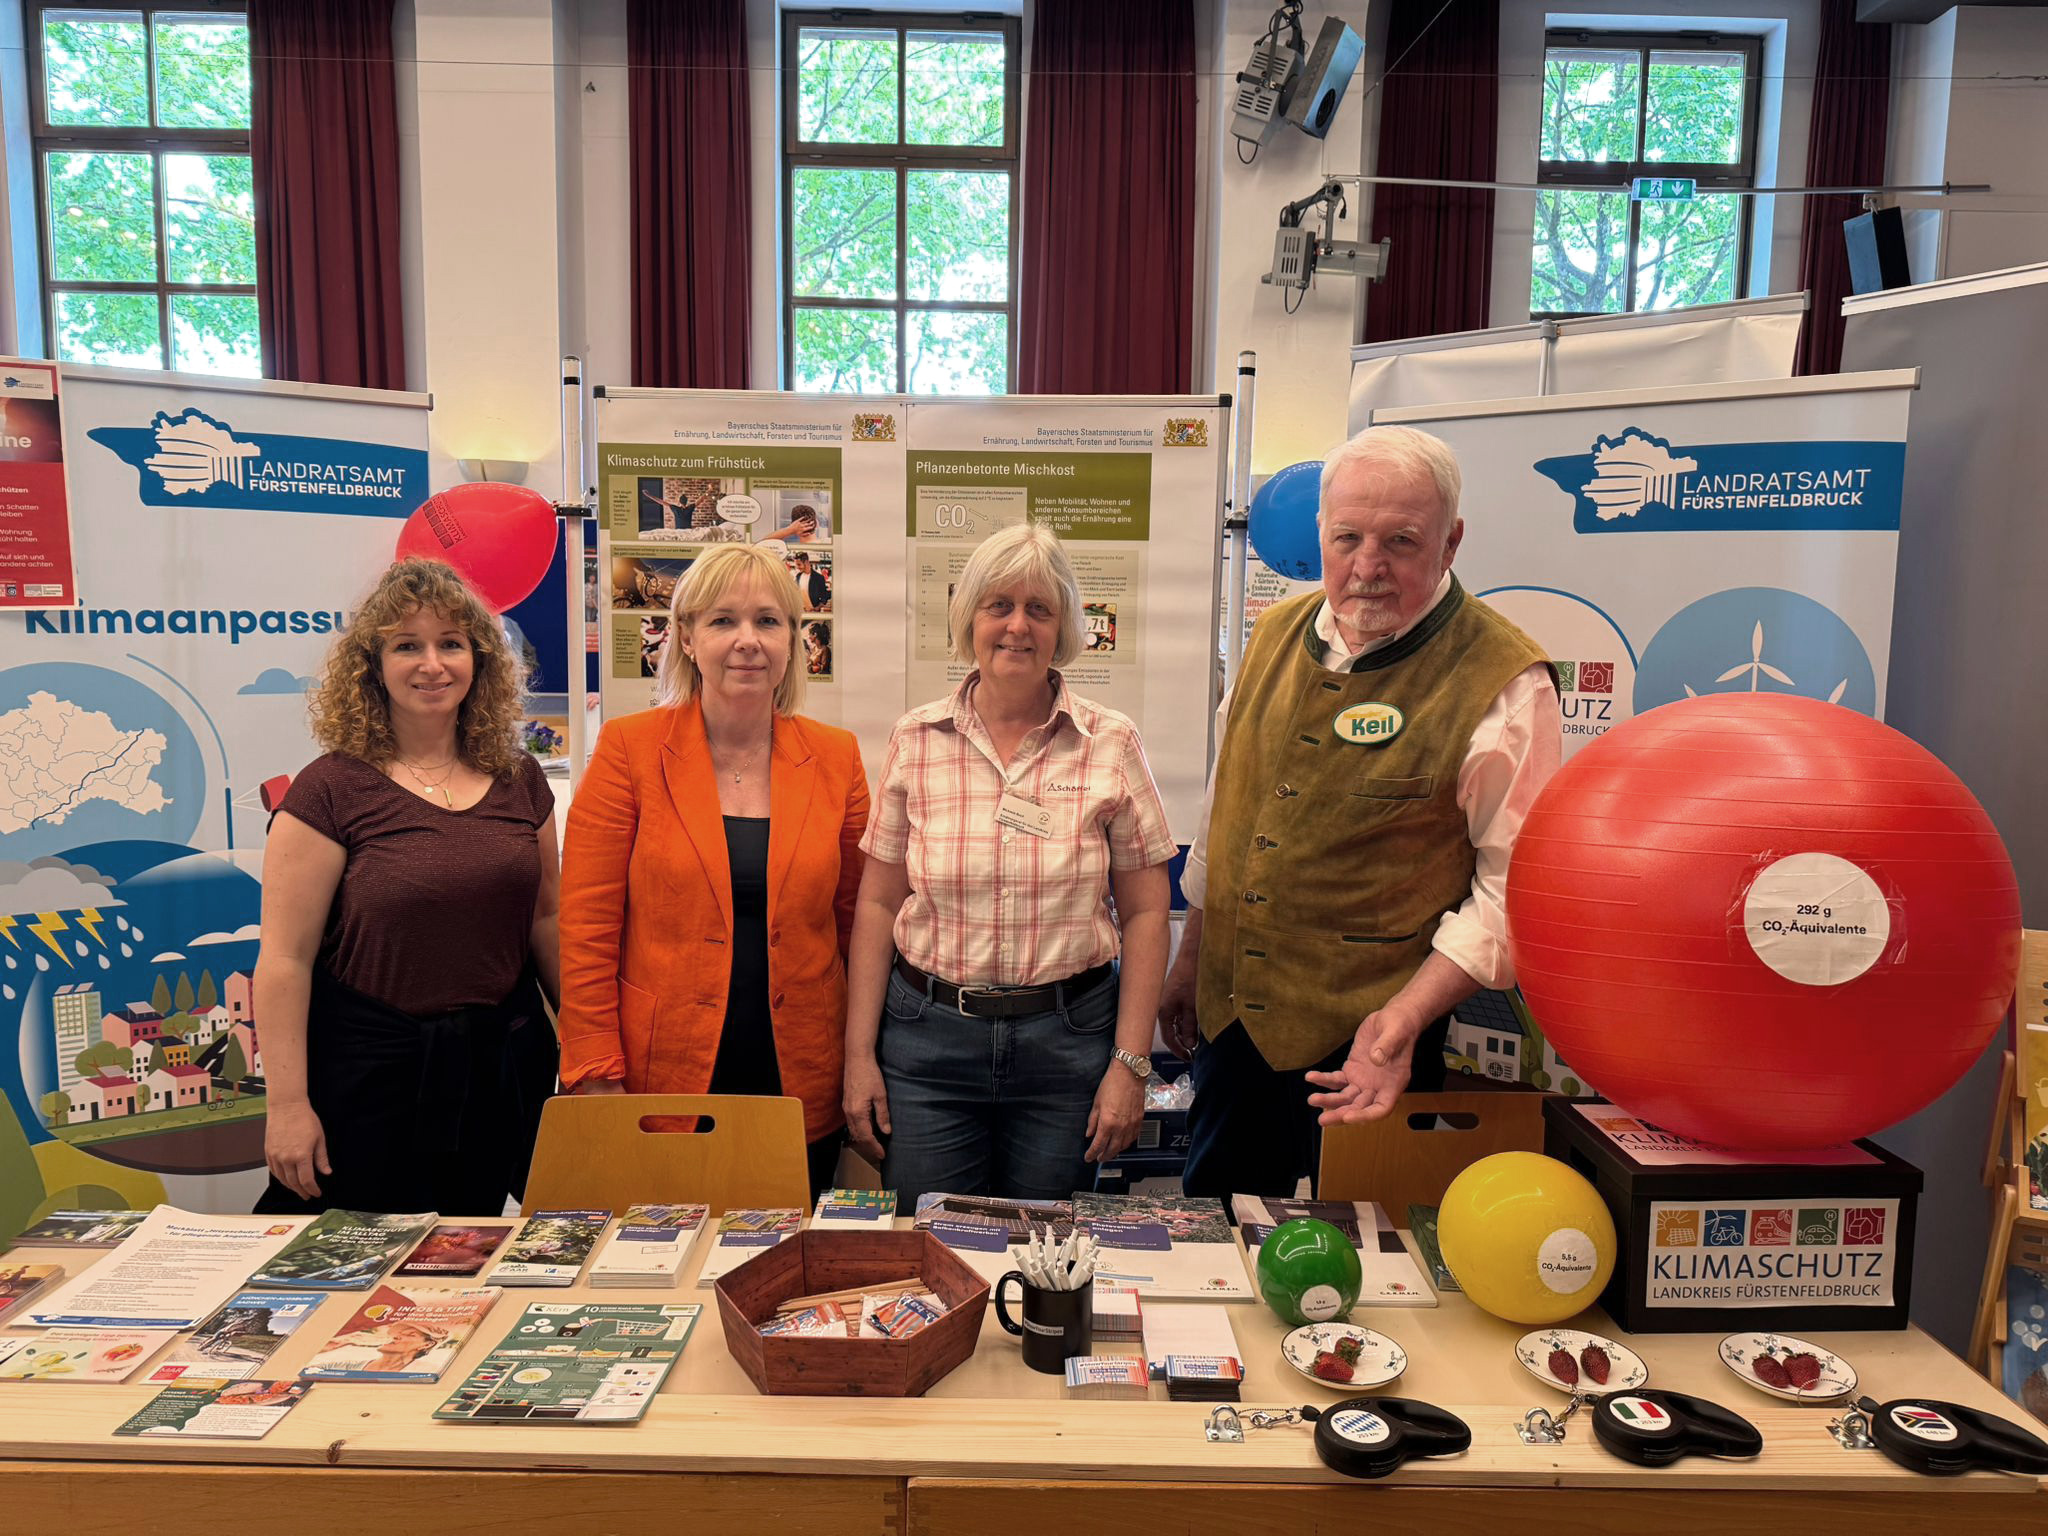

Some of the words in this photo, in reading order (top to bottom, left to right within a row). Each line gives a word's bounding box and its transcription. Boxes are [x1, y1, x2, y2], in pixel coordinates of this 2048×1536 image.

[727, 421, 769, 432] Bayerisches
[770, 422, 830, 432] Staatsministerium
[831, 422, 842, 431] für
[1037, 427, 1079, 438] Bayerisches
[1080, 428, 1142, 438] Staatsministerium
[1143, 428, 1154, 437] für
[674, 430, 711, 440] Ernährung,
[712, 430, 765, 441] Landwirtschaft,
[766, 431, 793, 440] Forsten
[794, 431, 807, 440] und
[808, 432, 842, 441] Tourismus
[983, 436, 1020, 446] Ernährung,
[1021, 436, 1075, 447] Landwirtschaft,
[1076, 437, 1103, 446] Forsten
[1104, 437, 1117, 446] und
[1118, 438, 1153, 447] Tourismus
[606, 453, 678, 468] Klimaschutz
[680, 457, 704, 468] zum
[707, 455, 765, 470] Frühstück
[249, 459, 406, 485] LANDRATSAMT
[916, 461, 1010, 476] Pflanzenbetonte
[1013, 462, 1075, 476] Mischkost
[249, 476, 402, 499] FÜRSTENFELDBRUCK
[1683, 468, 1872, 495] LANDRATSAMT
[1034, 497, 1056, 506] Neben
[1057, 497, 1088, 507] Mobilität,
[1089, 498, 1116, 506] Wohnen
[1118, 498, 1131, 506] und
[1682, 491, 1864, 510] FÜRSTENFELDBRUCK
[1034, 506, 1061, 514] anderen
[1062, 506, 1122, 515] Konsumbereichen
[1053, 514, 1070, 523] auch
[1071, 514, 1081, 523] die
[1082, 514, 1116, 525] Ernährung
[1117, 515, 1132, 523] eine
[1055, 523, 1073, 531] Rolle.
[1351, 715, 1394, 737] Keil
[1796, 904, 1820, 915] 292
[1823, 907, 1832, 918] g
[166, 1224, 204, 1232] Merkblatt
[341, 1225, 409, 1233] KLIMASCHUTZ
[1653, 1252, 1883, 1281] KLIMASCHUTZ
[1652, 1286, 1732, 1299] LANDKREIS
[1736, 1283, 1881, 1298] FÜRSTENFELDBRUCK
